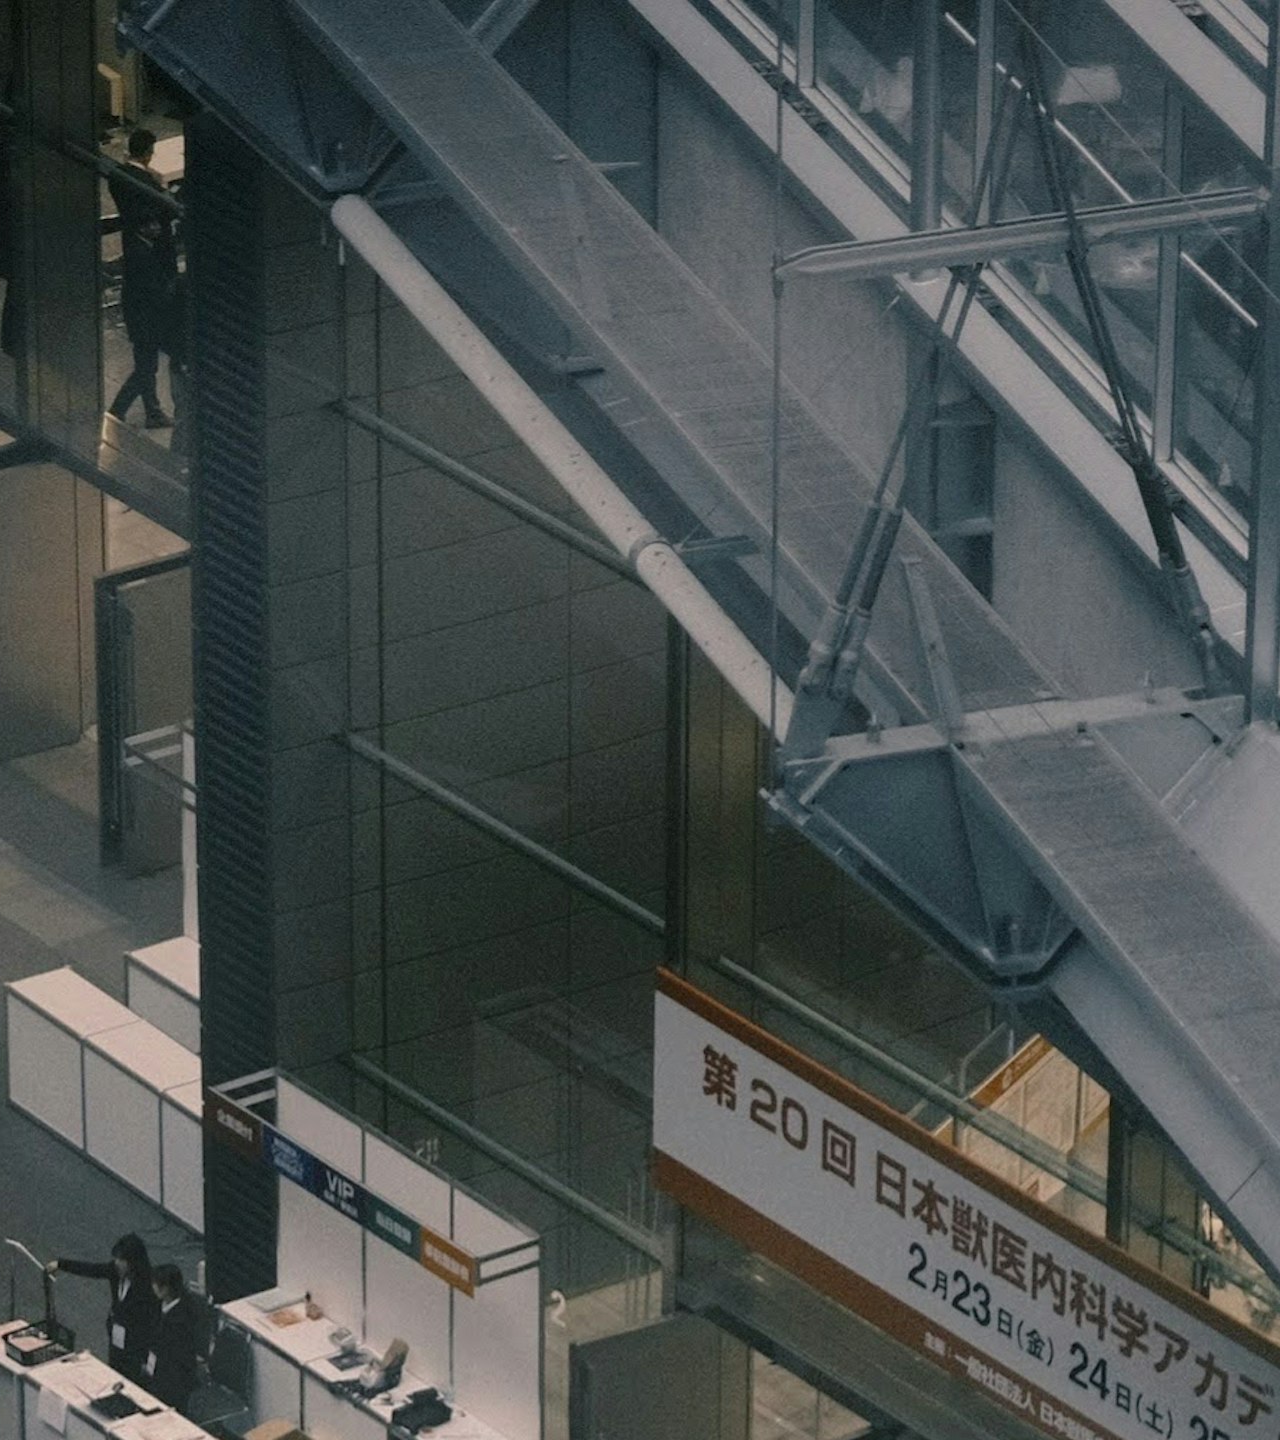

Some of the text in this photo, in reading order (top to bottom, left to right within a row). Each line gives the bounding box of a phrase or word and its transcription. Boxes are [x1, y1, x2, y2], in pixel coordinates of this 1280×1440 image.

[325, 1170, 355, 1200] VIP
[703, 1044, 856, 1188] 第20回
[908, 1242, 1054, 1366] 2月23日(金)
[1069, 1342, 1174, 1440] 24日(土)
